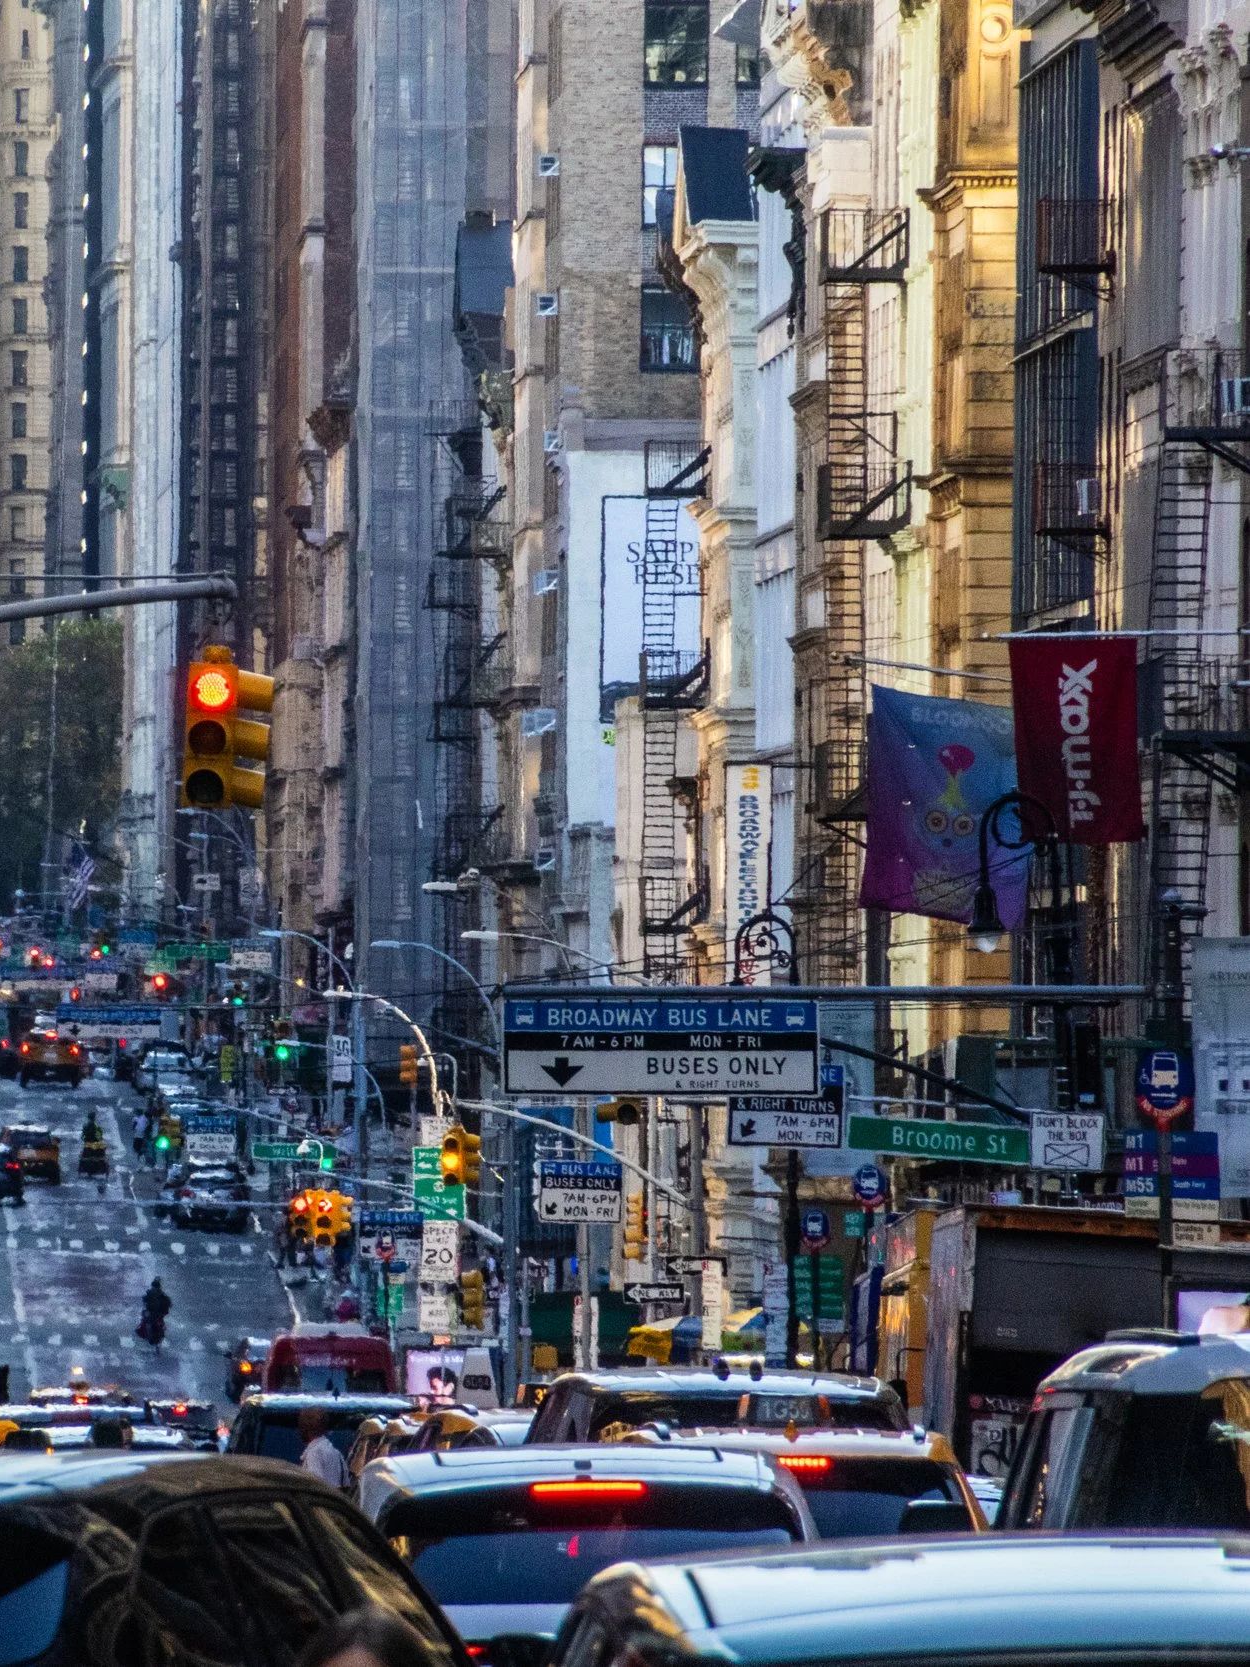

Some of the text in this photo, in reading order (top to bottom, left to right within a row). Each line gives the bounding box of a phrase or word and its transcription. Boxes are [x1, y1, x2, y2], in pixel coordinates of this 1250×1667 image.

[626, 541, 700, 563] SAPP
[548, 1008, 772, 1027] BROADWAY BUS LANE
[690, 1035, 722, 1048] MON
[738, 1035, 762, 1049] FRI
[647, 1056, 787, 1076] BUSES ONLY
[689, 1080, 719, 1089] RIGHT
[725, 1079, 761, 1089] TURNS
[750, 1098, 788, 1112] RIGHT
[792, 1099, 836, 1113] TURNS
[1036, 1116, 1098, 1129] DON'T BLOCK
[777, 1131, 835, 1143] MON FRI
[892, 1126, 1007, 1154] Broome St
[1048, 1131, 1087, 1141] THE BOX
[1126, 1134, 1143, 1149] M1
[561, 1164, 618, 1176] BUS LANE
[1126, 1156, 1143, 1171] M1
[545, 1177, 616, 1190] BUSES ONLY
[1126, 1177, 1154, 1193] M55
[425, 1247, 453, 1264] 20
